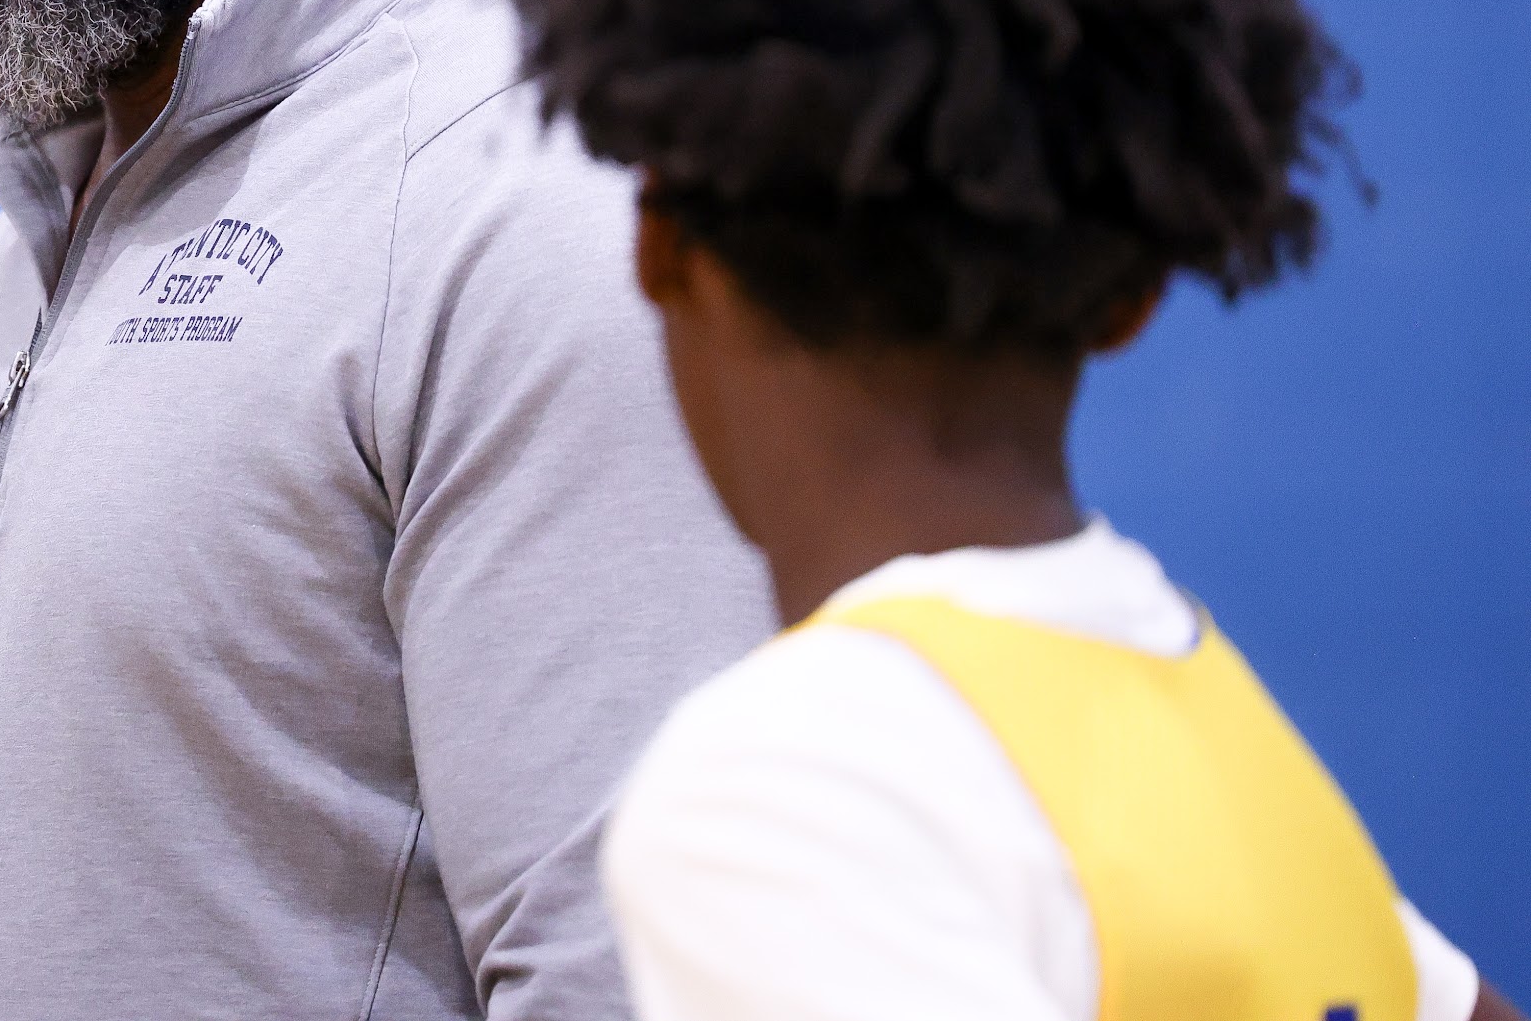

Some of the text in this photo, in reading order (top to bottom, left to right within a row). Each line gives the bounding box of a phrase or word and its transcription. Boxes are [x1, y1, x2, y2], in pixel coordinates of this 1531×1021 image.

[237, 226, 283, 285] CITY
[157, 274, 224, 304] STAFF
[138, 316, 185, 343] SPORTS
[180, 315, 243, 343] PROGRAM
